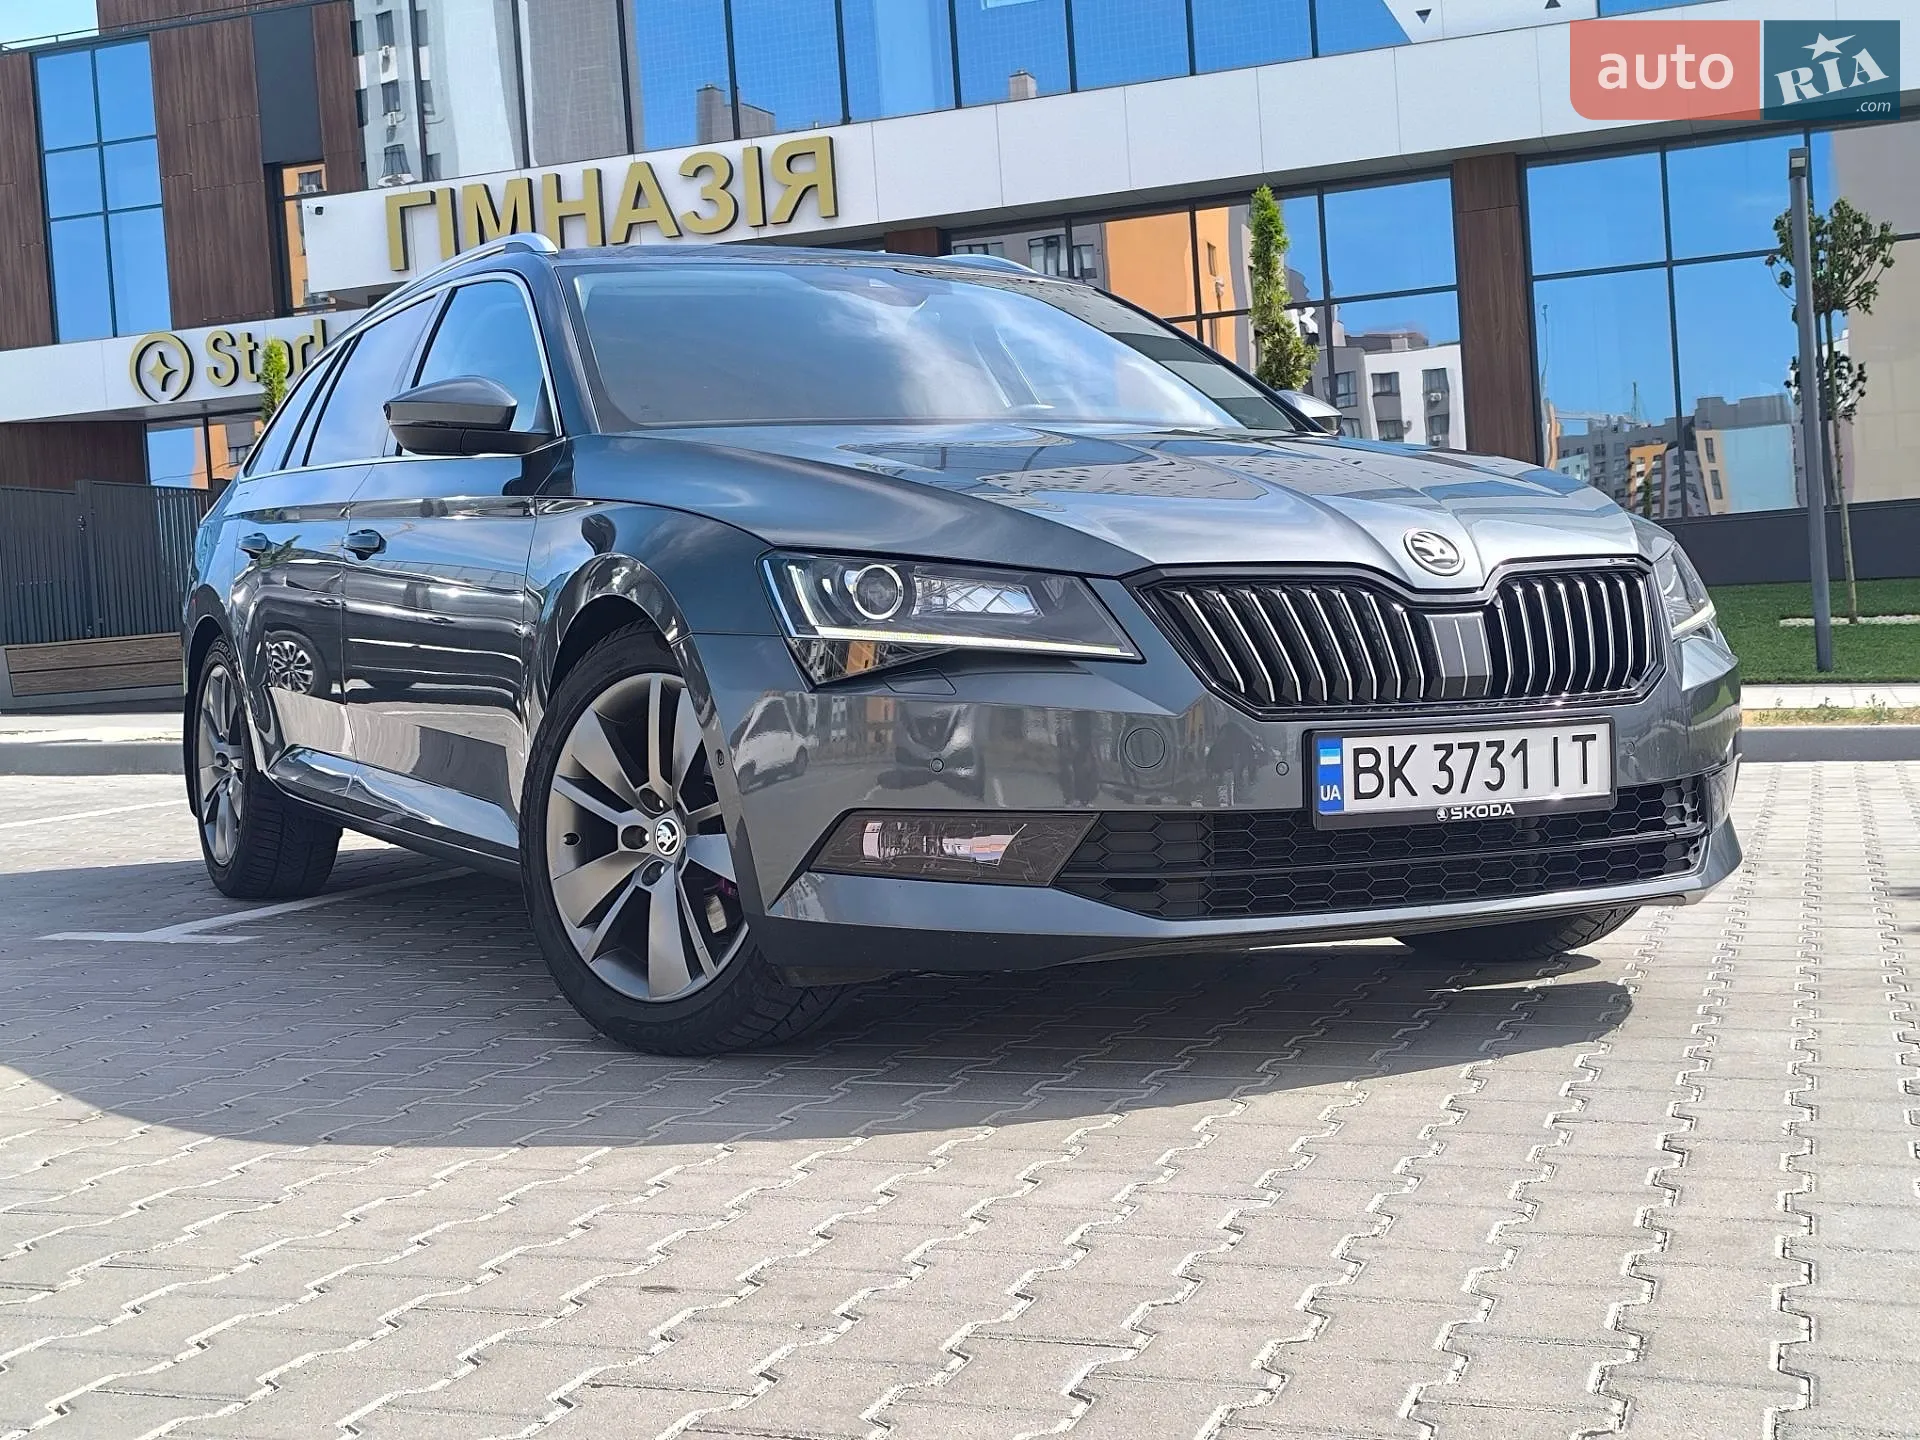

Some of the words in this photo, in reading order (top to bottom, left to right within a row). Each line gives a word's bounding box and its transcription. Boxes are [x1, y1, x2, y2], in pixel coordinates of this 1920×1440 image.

[385, 136, 838, 270] ГІМНАЗІЯ
[1320, 785, 1342, 802] UA
[1353, 745, 1418, 800] BK
[1432, 738, 1529, 794] 3731
[1553, 733, 1597, 787] IT
